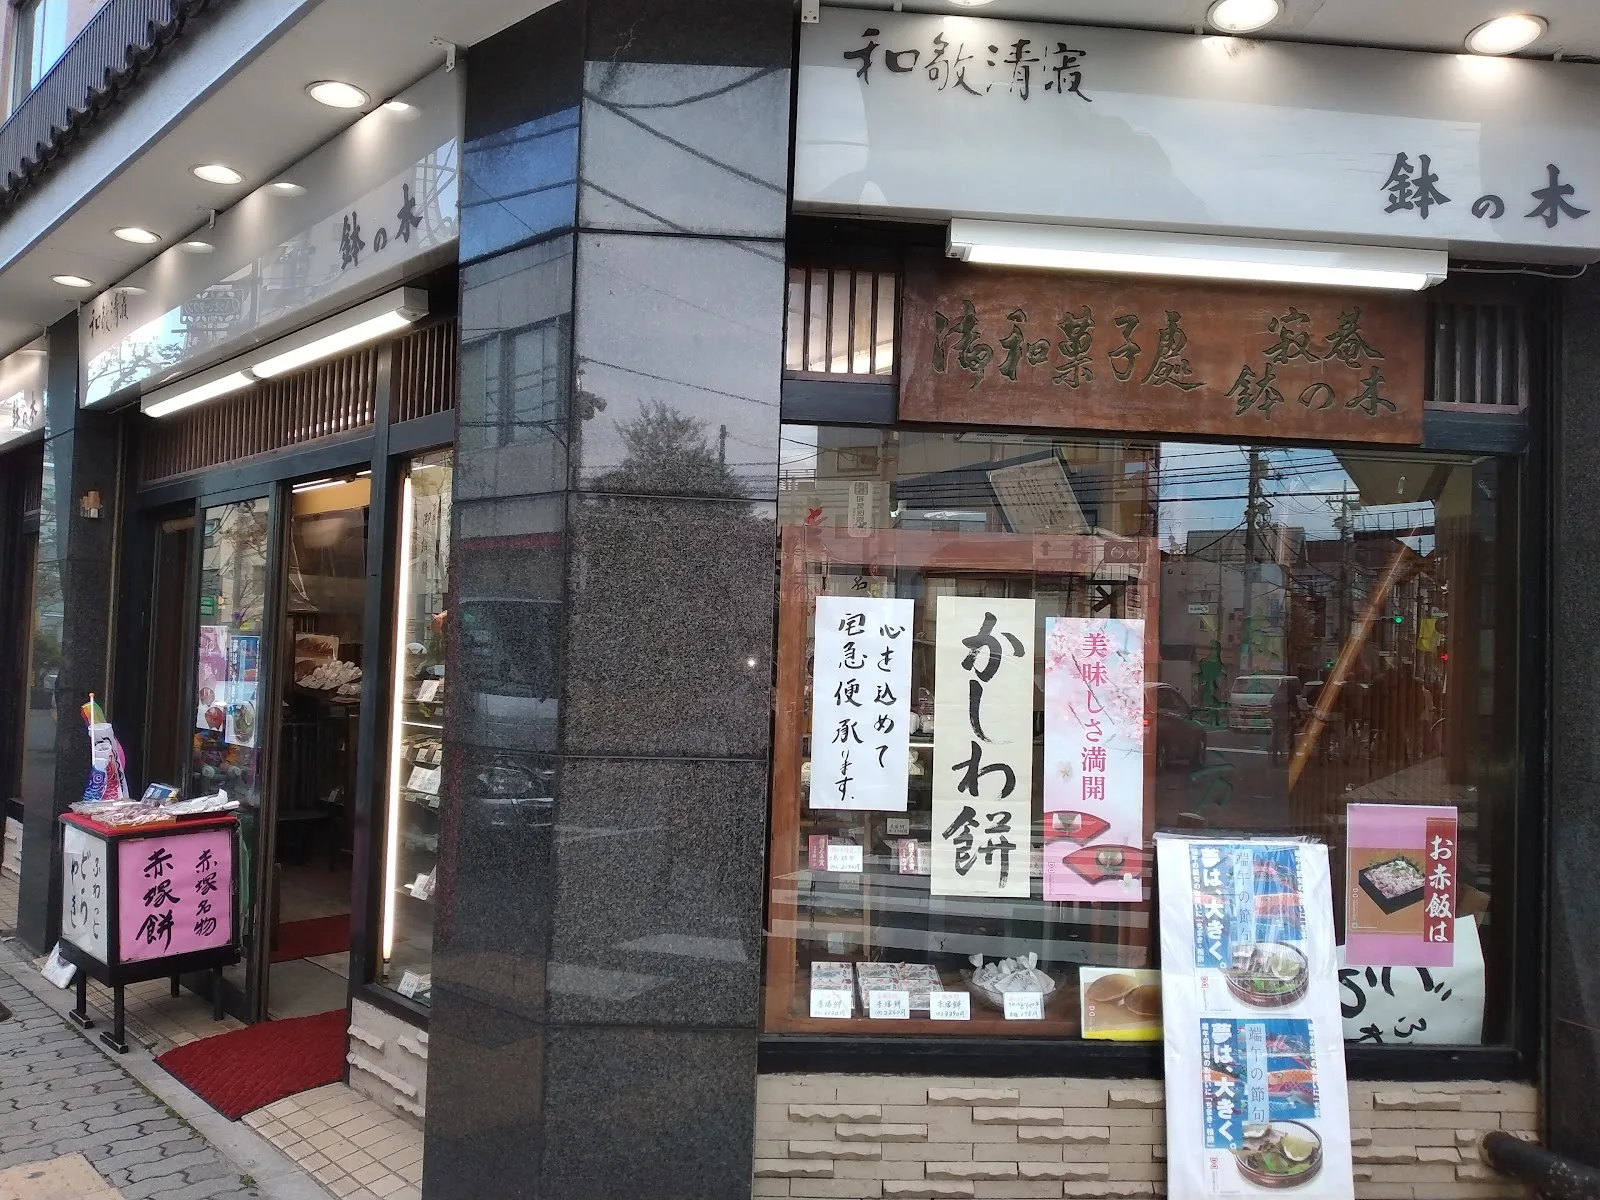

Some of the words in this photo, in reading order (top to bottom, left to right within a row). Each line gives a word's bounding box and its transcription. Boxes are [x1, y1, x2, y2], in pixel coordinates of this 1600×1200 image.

[339, 183, 424, 270] 鉢の木
[1379, 151, 1592, 229] 鉢の木
[1224, 362, 1398, 421] 鉢の木
[874, 623, 906, 768] 心を込めて
[1081, 632, 1108, 801] 美味しさ満開
[941, 611, 1027, 889] かしわ餅
[135, 847, 181, 954] 赤塚餅
[194, 848, 218, 937] 赤塚名物
[1425, 835, 1454, 942] お赤飯は
[1211, 1023, 1237, 1149] 夢は、大きく。
[1249, 1026, 1265, 1123] 端午の節句
